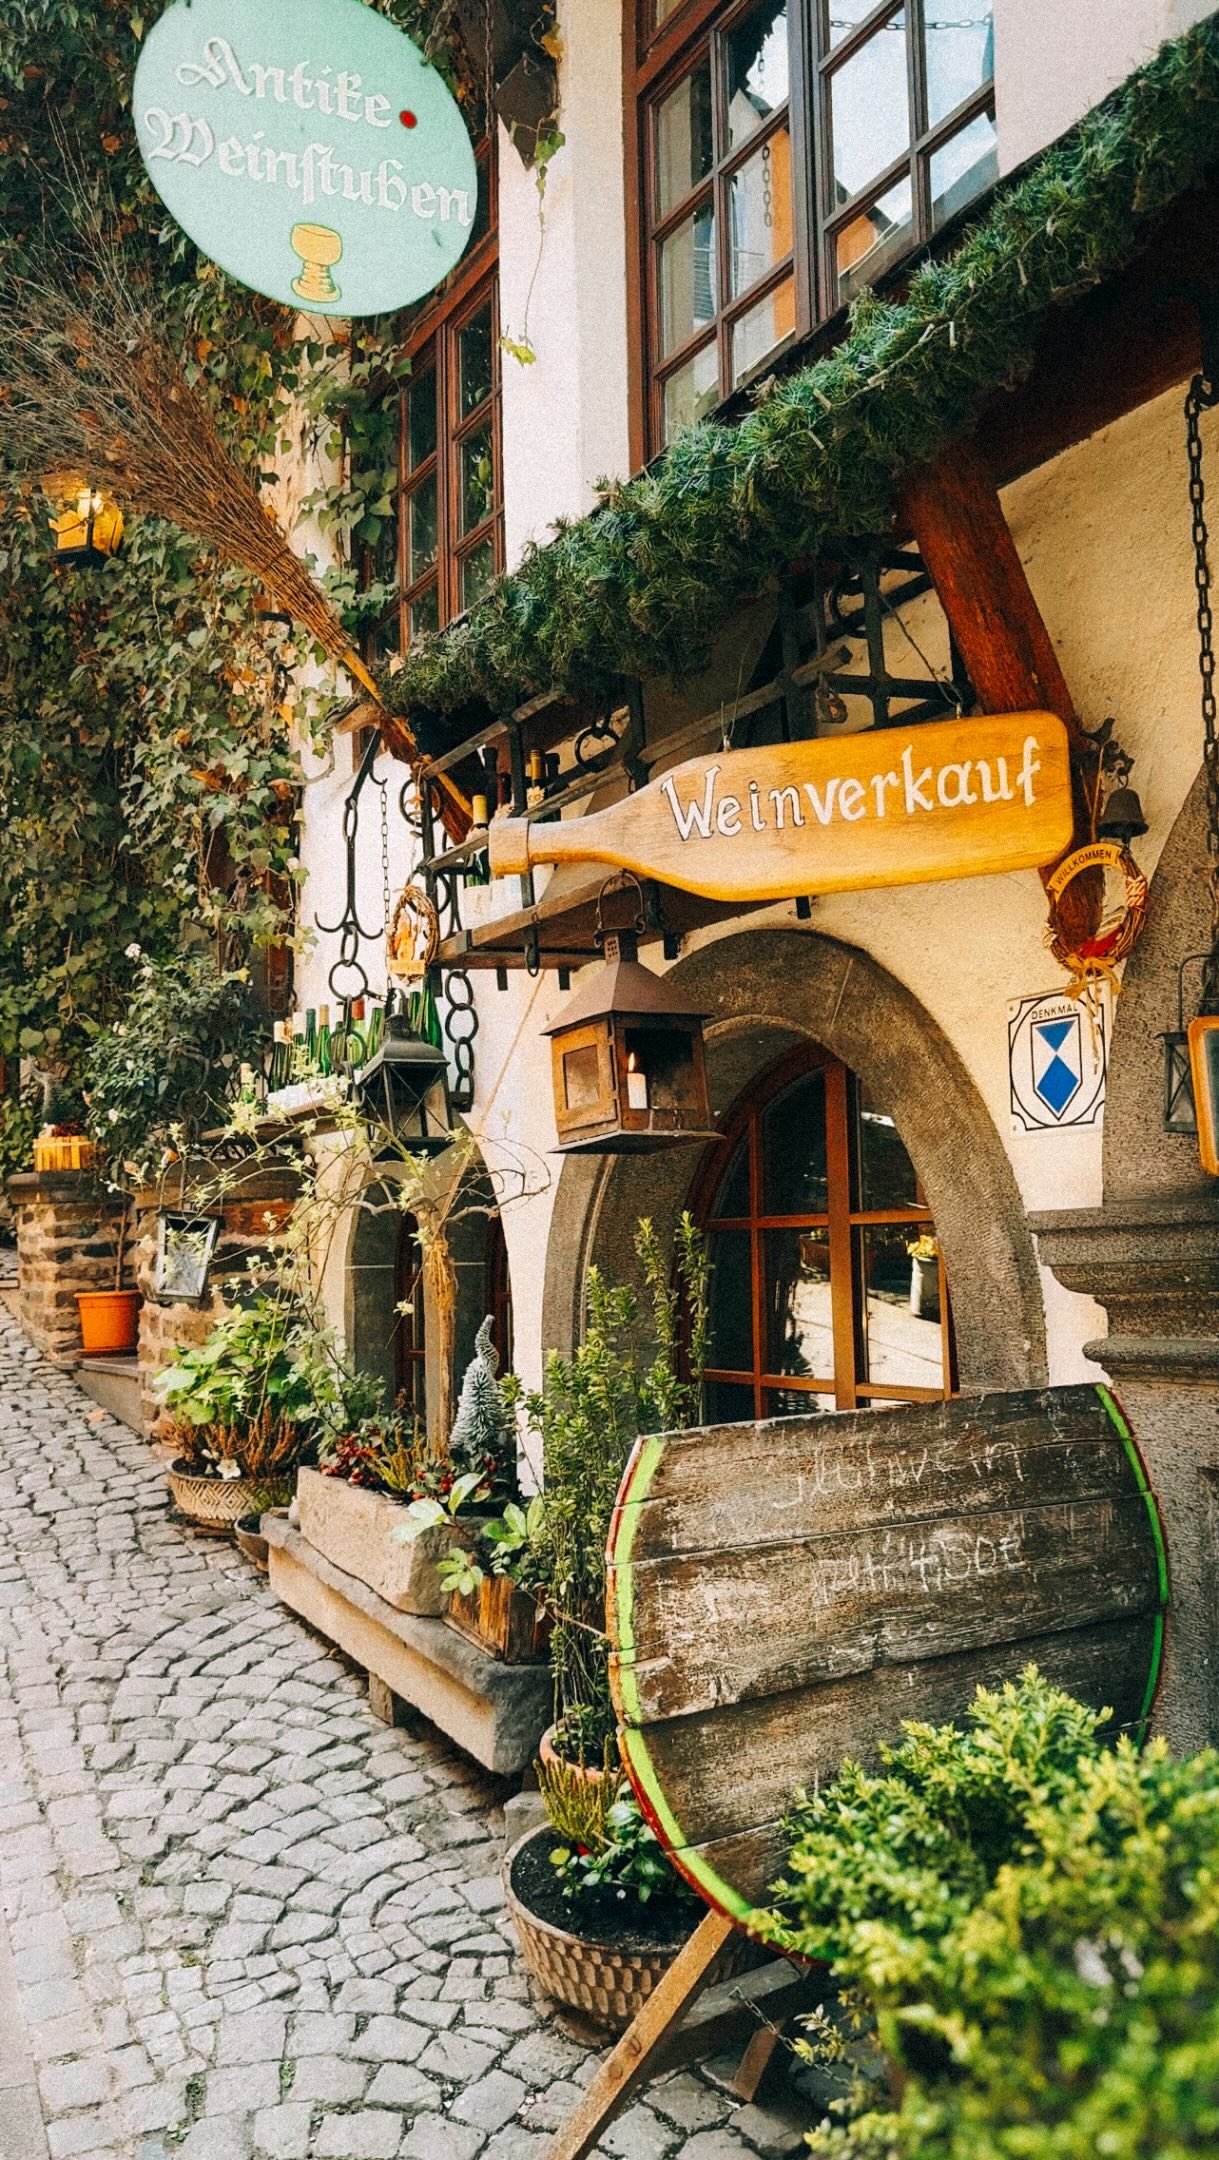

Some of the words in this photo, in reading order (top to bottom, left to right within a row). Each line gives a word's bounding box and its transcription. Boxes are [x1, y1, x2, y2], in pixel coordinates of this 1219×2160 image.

[174, 36, 392, 129] Antike
[660, 734, 1041, 842] Weinverkauf
[1057, 849, 1112, 884] WILLKOMMEN
[1031, 1005, 1079, 1020] DENKMAL
